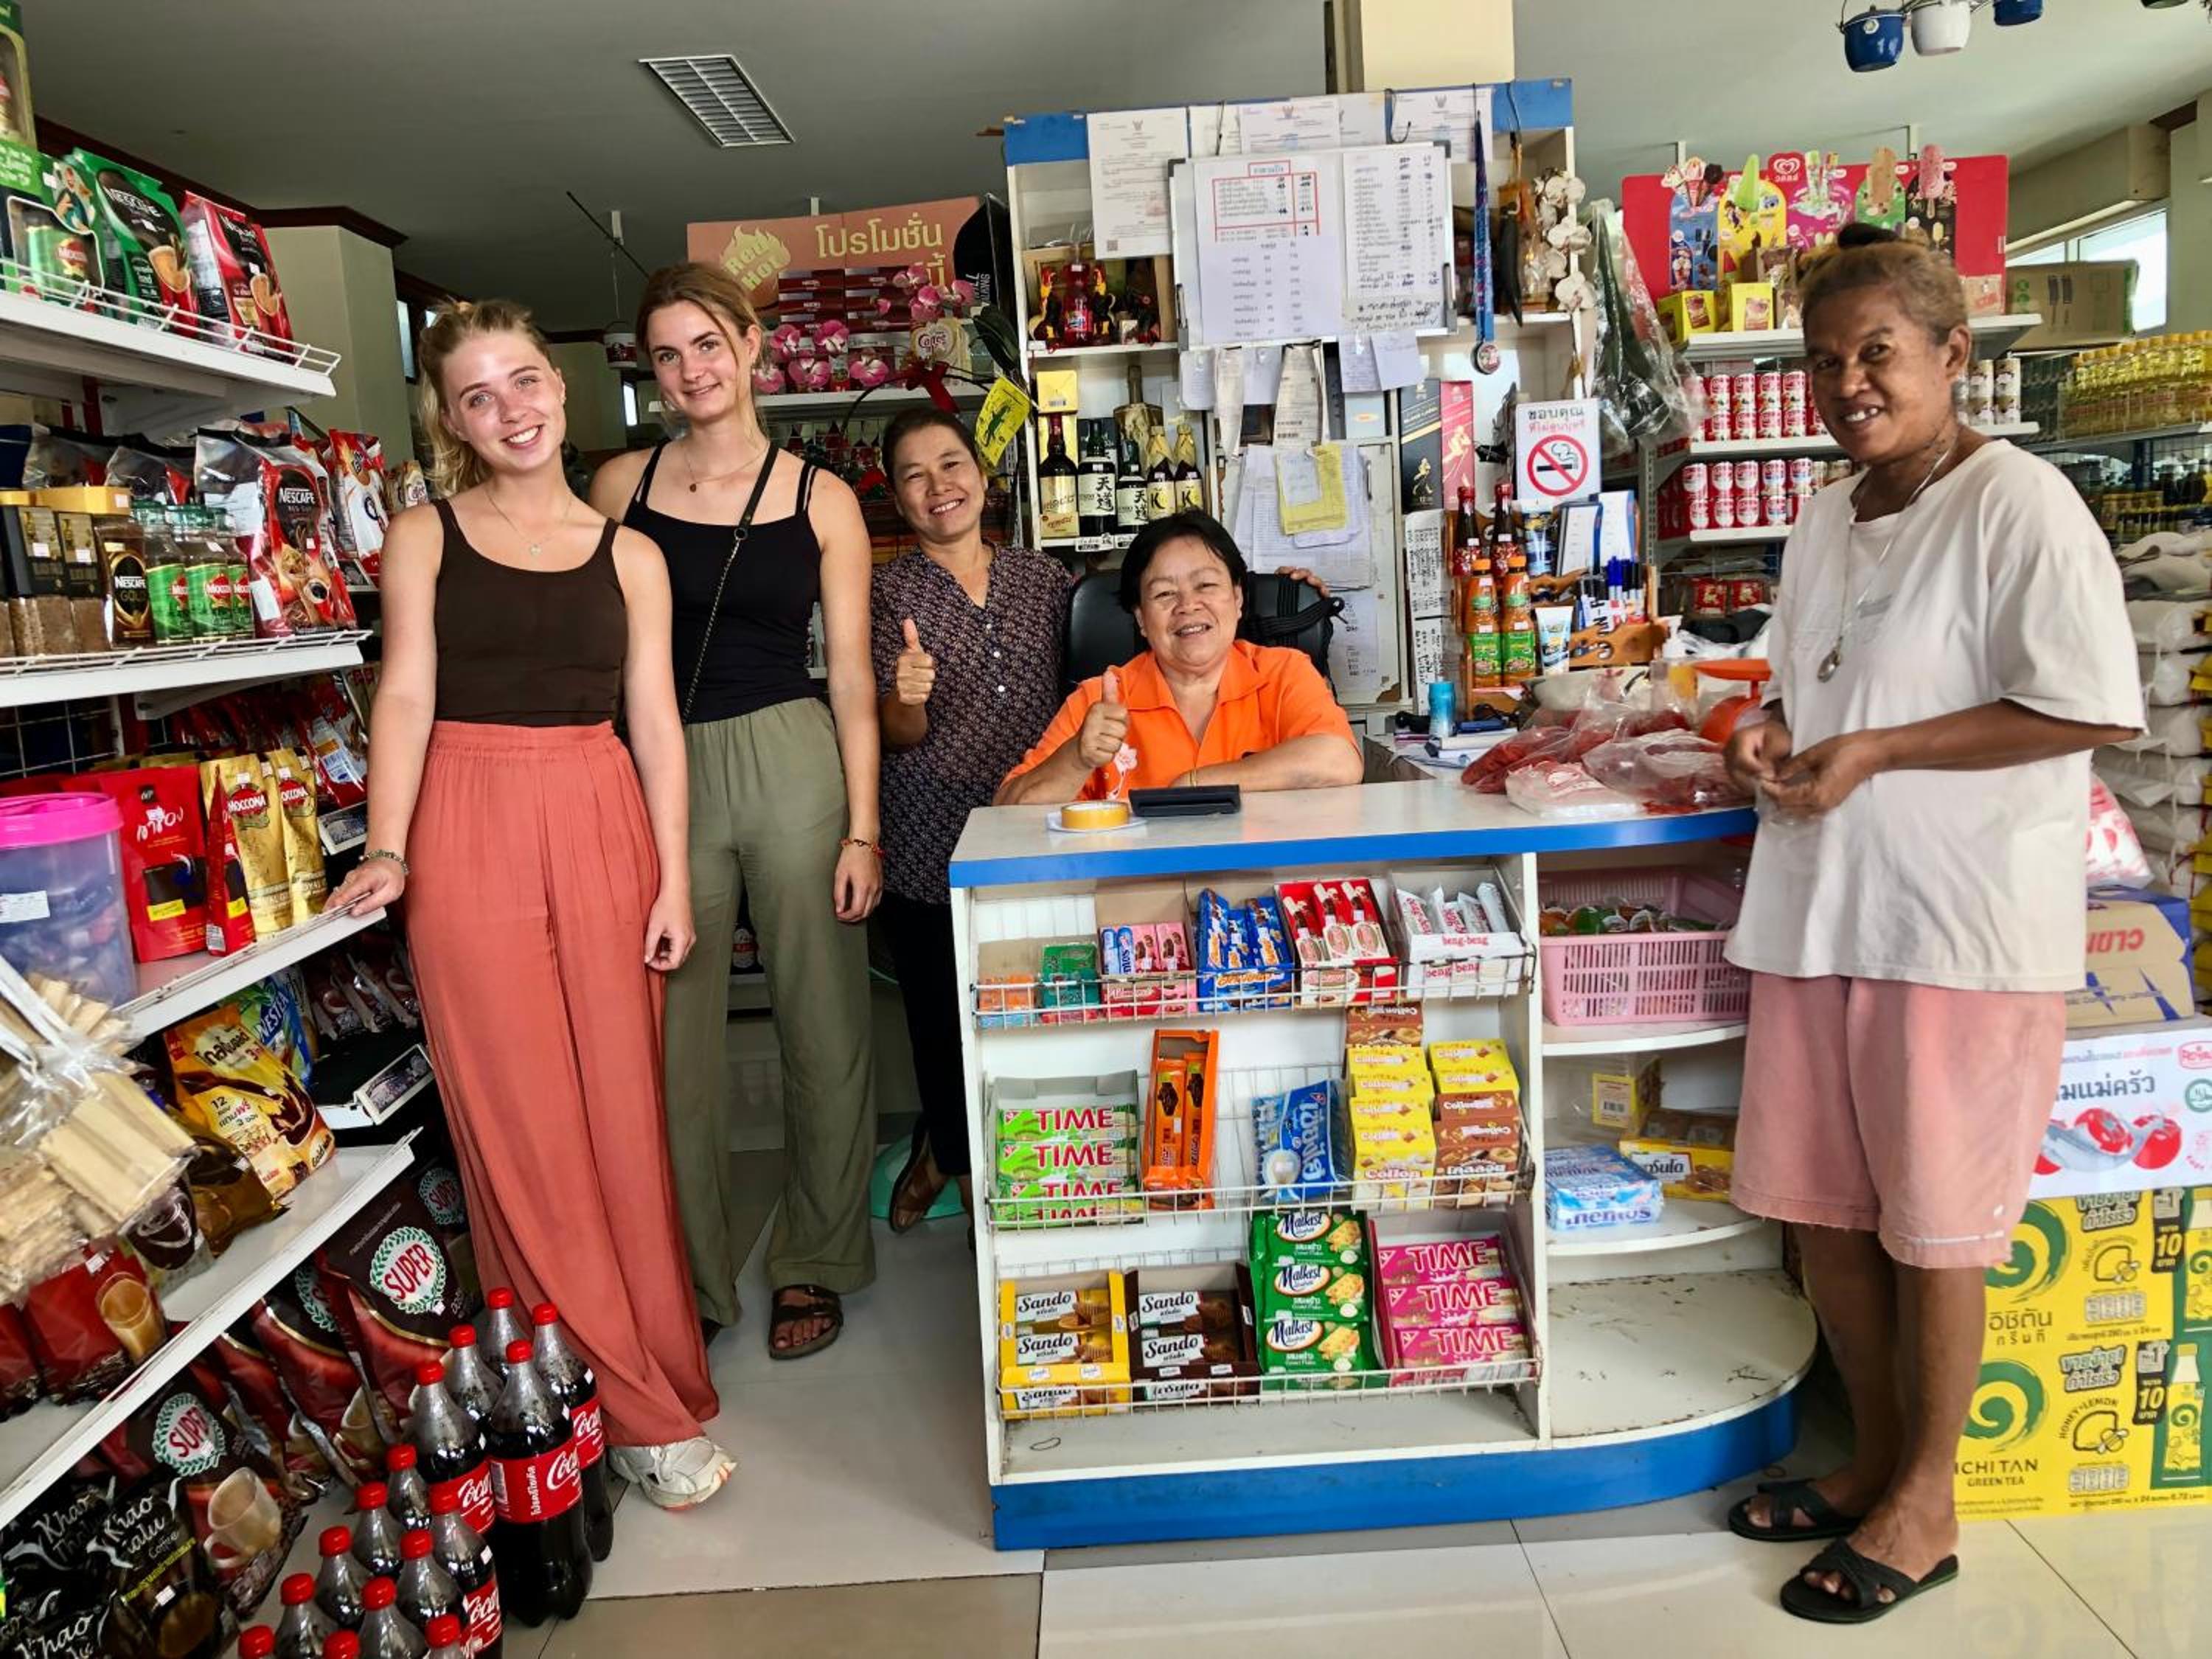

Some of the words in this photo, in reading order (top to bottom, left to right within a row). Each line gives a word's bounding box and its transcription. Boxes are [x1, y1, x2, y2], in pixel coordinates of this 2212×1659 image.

[815, 212, 943, 258] โปรโมชั่น
[1528, 406, 1584, 421] ขอบคุณ
[227, 796, 266, 813] MOCCONA
[279, 786, 309, 801] OCCONA
[1441, 936, 1489, 948] beng-beng
[1425, 961, 1480, 977] bengbeng
[2055, 1069, 2156, 1102] มแม่ครัว
[1036, 1107, 1113, 1131] TIME
[1033, 1143, 1113, 1168] TIME
[1364, 1167, 1422, 1180] Collon
[1041, 1180, 1122, 1198] TIME
[1282, 1213, 1322, 1237] Malkist
[1565, 1206, 1652, 1225] mentos
[2157, 1233, 2183, 1256] 10
[1405, 1242, 1489, 1273] TIME
[384, 1244, 434, 1300] SUPER
[1279, 1265, 1321, 1292] Malkist
[1018, 1291, 1071, 1312] Sando
[1142, 1291, 1194, 1312] Sando
[1417, 1281, 1500, 1312] TIME
[1989, 1308, 2053, 1331] อิชิตัน
[1018, 1333, 1074, 1354] Sando
[1273, 1320, 1314, 1346] Malkist
[1430, 1328, 1512, 1355] TIME
[1145, 1335, 1198, 1359] Sando
[2139, 1386, 2165, 1410] 10
[1967, 1478, 2003, 1487] GREEN
[2005, 1476, 2025, 1486] TEA
